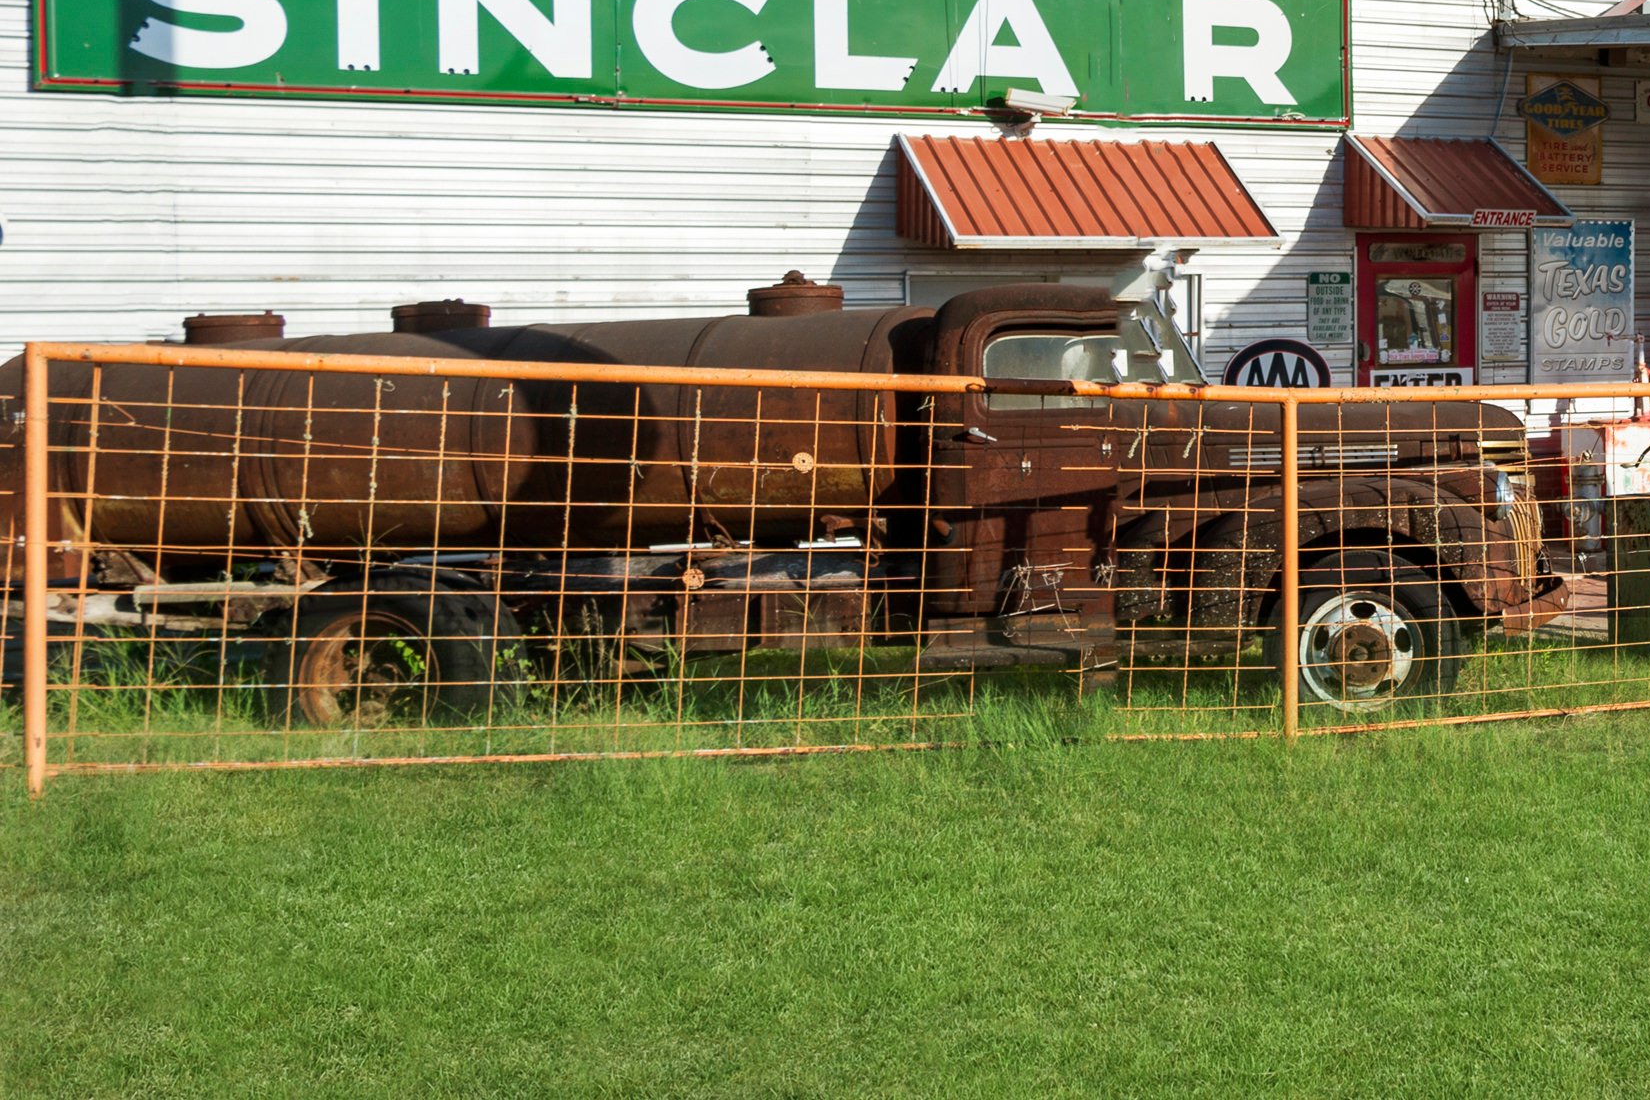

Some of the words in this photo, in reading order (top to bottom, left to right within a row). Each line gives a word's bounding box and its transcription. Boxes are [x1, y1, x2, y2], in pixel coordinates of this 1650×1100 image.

[1547, 118, 1584, 129] TIRES
[1542, 140, 1568, 151] TIRE
[1538, 152, 1593, 163] BATTERY
[1541, 163, 1589, 174] SERVICE
[1473, 210, 1534, 226] ENTRANCE
[1543, 233, 1625, 248] Valuable
[1318, 273, 1341, 284] NO
[1538, 260, 1626, 303] TEXAS
[1315, 286, 1344, 295] OUTSIDE
[1310, 297, 1324, 306] FOOD
[1333, 297, 1349, 306] DRINK
[1313, 307, 1320, 315] OF
[1322, 307, 1332, 315] ANY
[1334, 307, 1346, 315] TYPE
[1544, 306, 1627, 349] GOLD
[1540, 356, 1625, 372] STAMPS
